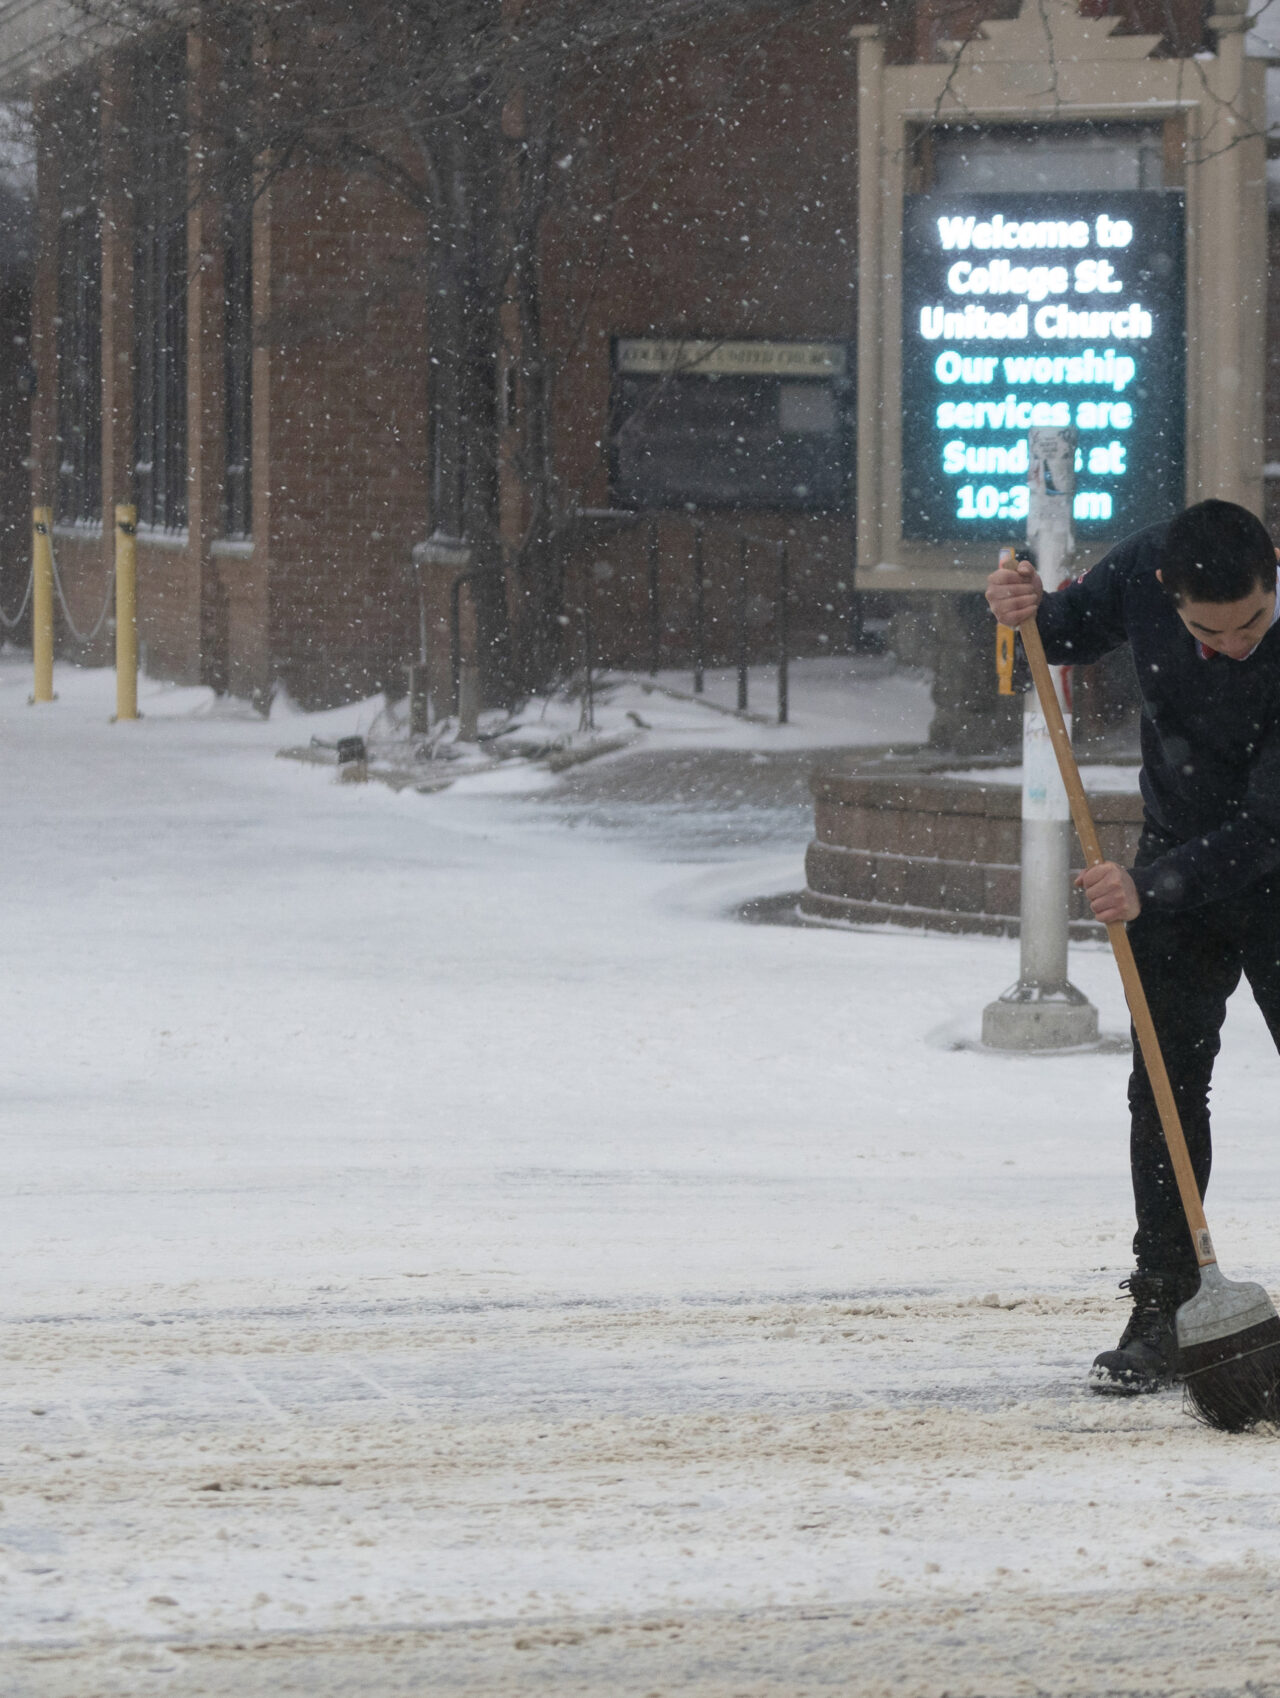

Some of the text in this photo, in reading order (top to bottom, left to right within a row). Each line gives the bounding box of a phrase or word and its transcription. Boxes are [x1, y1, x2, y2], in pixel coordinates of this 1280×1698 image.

[936, 213, 1133, 250] Welcome to
[947, 258, 1123, 302] College St.
[919, 302, 1153, 340] United Church
[934, 347, 1136, 392] Our worship
[936, 393, 1133, 430] services are
[942, 437, 1084, 475] Sund
[1087, 440, 1127, 475] at
[956, 484, 1113, 520] 10:3m
